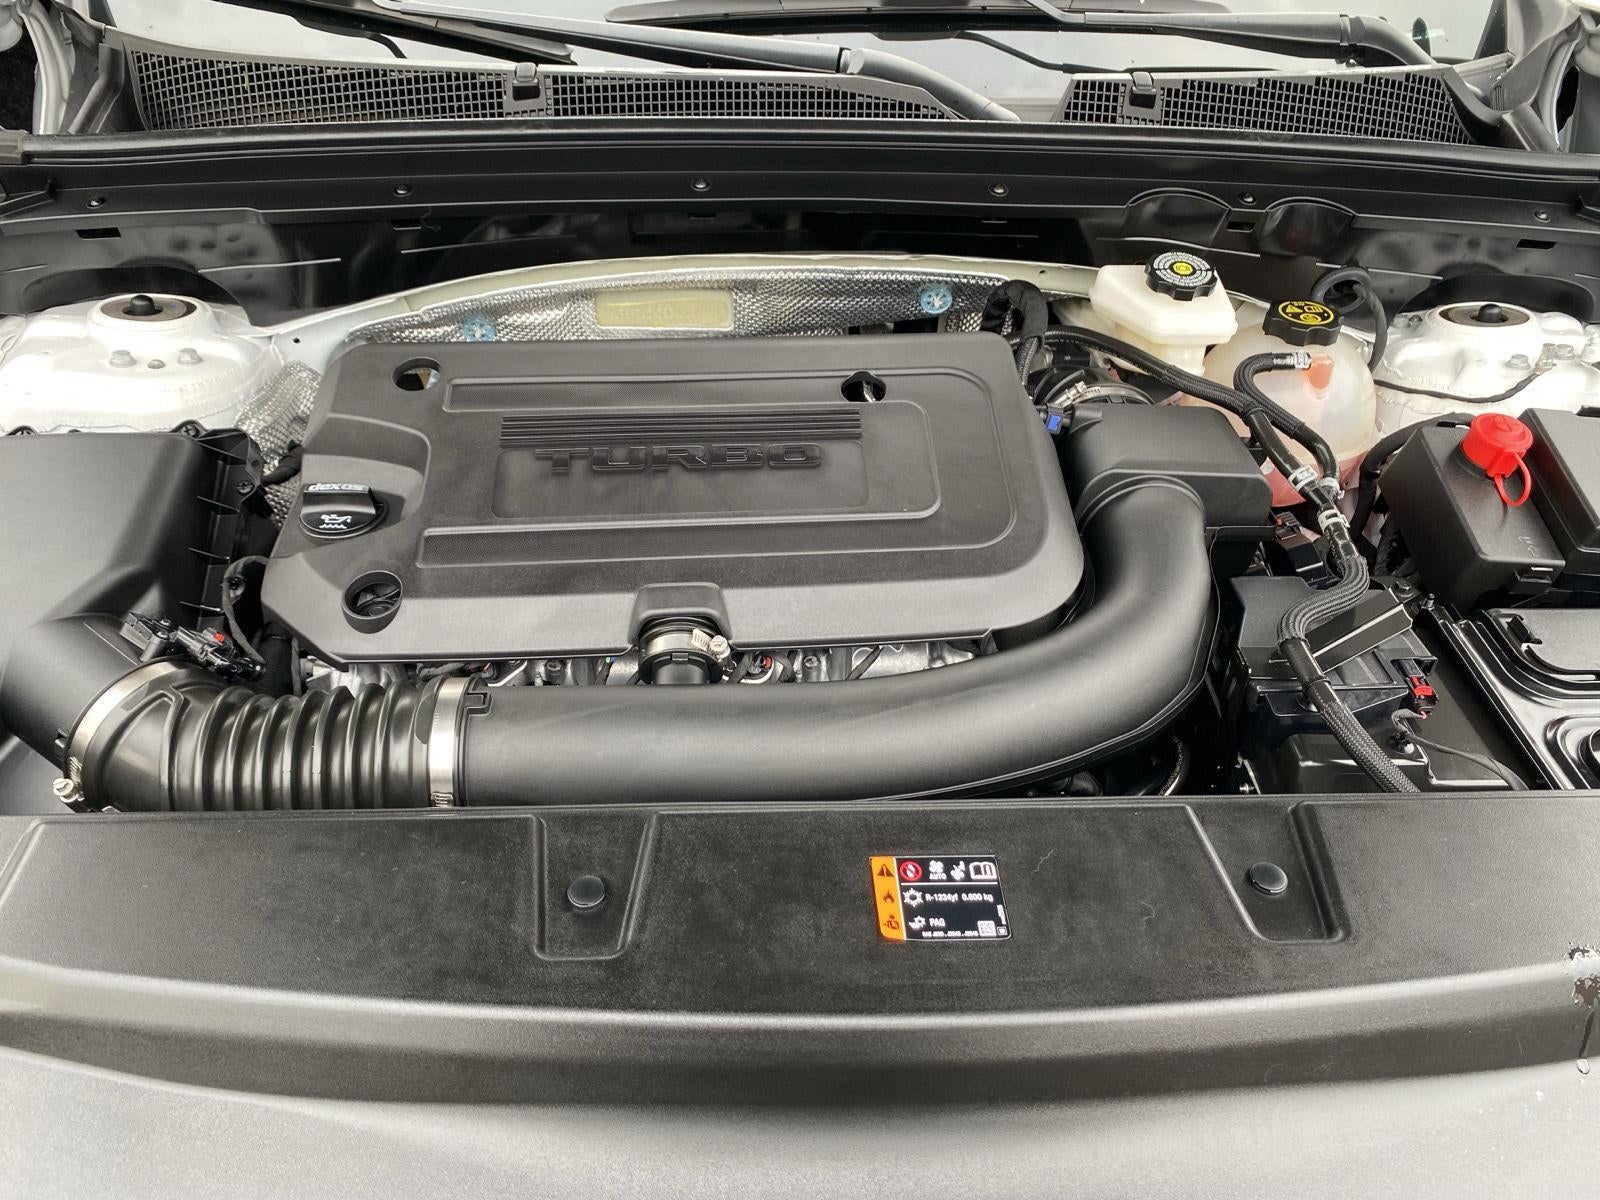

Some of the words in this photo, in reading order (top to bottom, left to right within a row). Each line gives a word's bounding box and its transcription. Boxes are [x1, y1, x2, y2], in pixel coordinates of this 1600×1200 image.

[535, 442, 820, 473] TURBO
[308, 483, 369, 491] dexos
[929, 872, 947, 880] AUTO
[983, 893, 994, 902] kg
[929, 918, 946, 927] PAG
